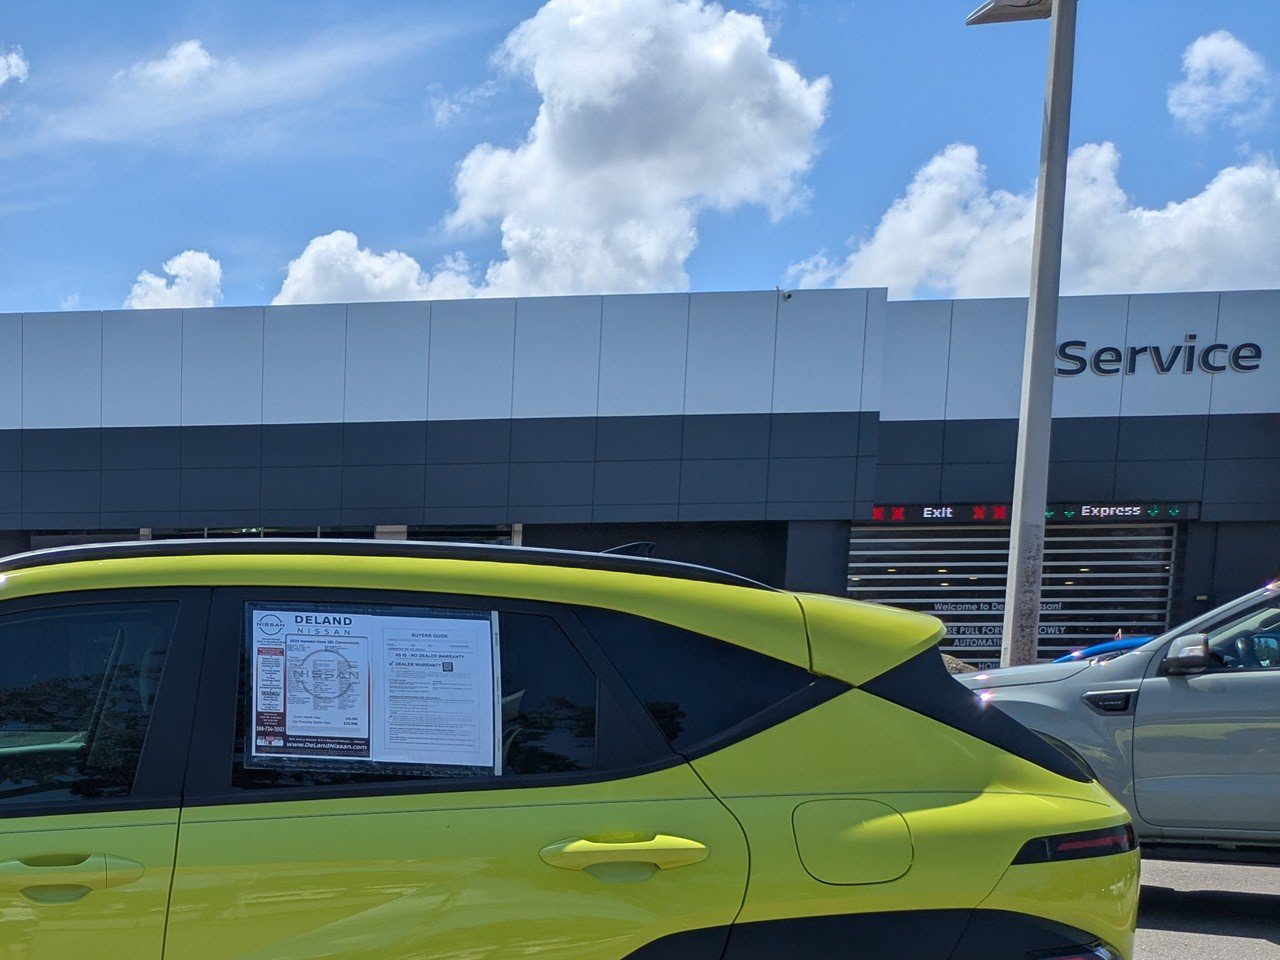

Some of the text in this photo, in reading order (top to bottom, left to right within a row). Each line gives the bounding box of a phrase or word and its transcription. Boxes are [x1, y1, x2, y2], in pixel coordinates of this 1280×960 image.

[1054, 334, 1262, 376] Service
[923, 507, 953, 518] Exit
[1081, 506, 1141, 518] Express
[934, 602, 978, 611] Welcome
[980, 603, 989, 611] to
[295, 615, 352, 626] DELAND
[960, 627, 979, 635] PULL
[293, 670, 359, 680] NISSAN
[286, 742, 368, 750] www.DeLandNissan.com
